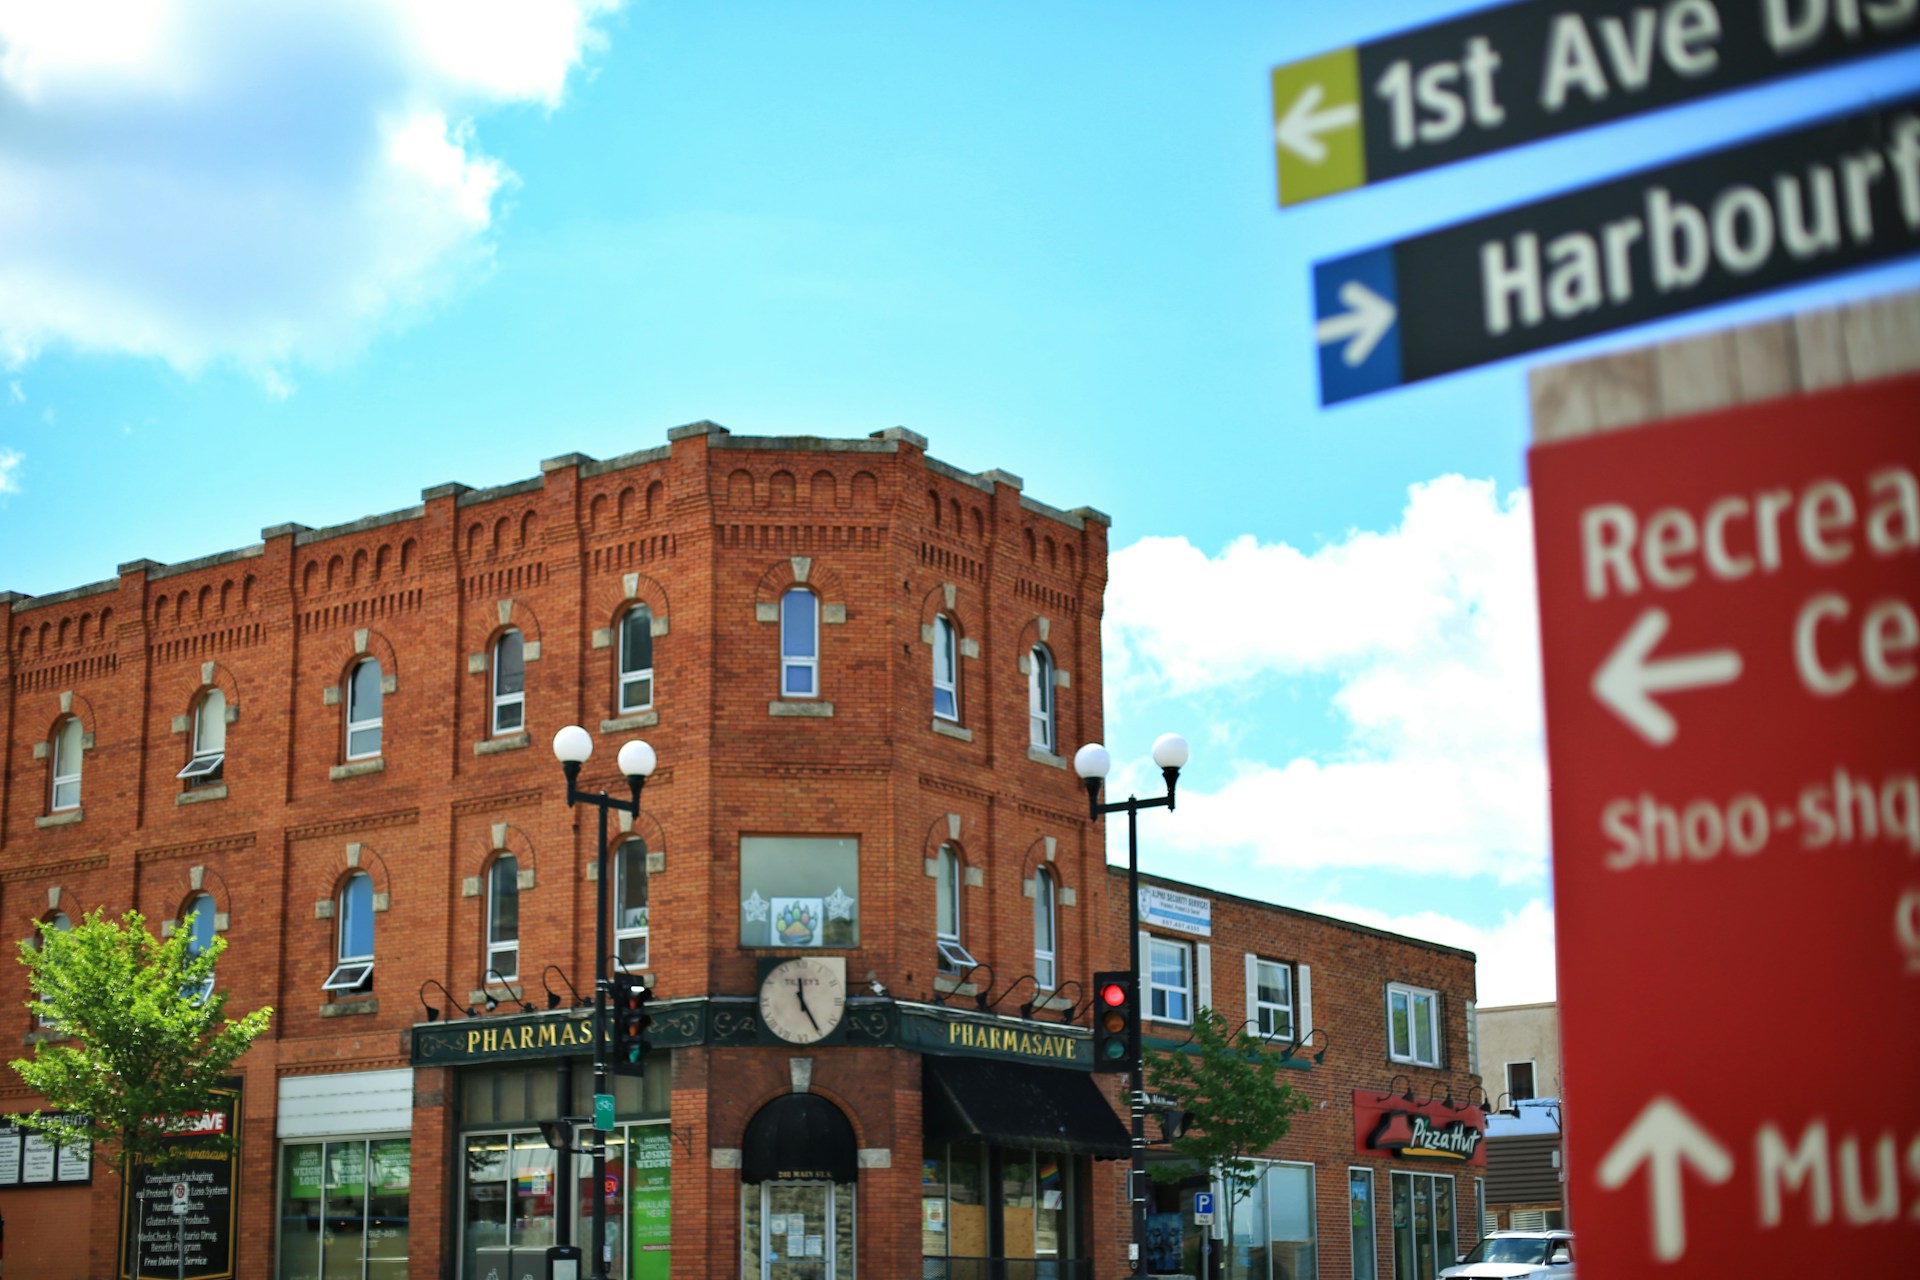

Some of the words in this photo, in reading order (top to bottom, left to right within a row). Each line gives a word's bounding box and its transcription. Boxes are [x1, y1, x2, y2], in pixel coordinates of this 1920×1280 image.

[1377, 36, 1504, 149] 1st
[1542, 0, 1721, 111] Ave
[1580, 468, 1920, 601] Recrea
[1793, 592, 1920, 697] Ce
[467, 1019, 615, 1053] PHARMAS
[949, 1021, 1077, 1060] PHARMASAVE
